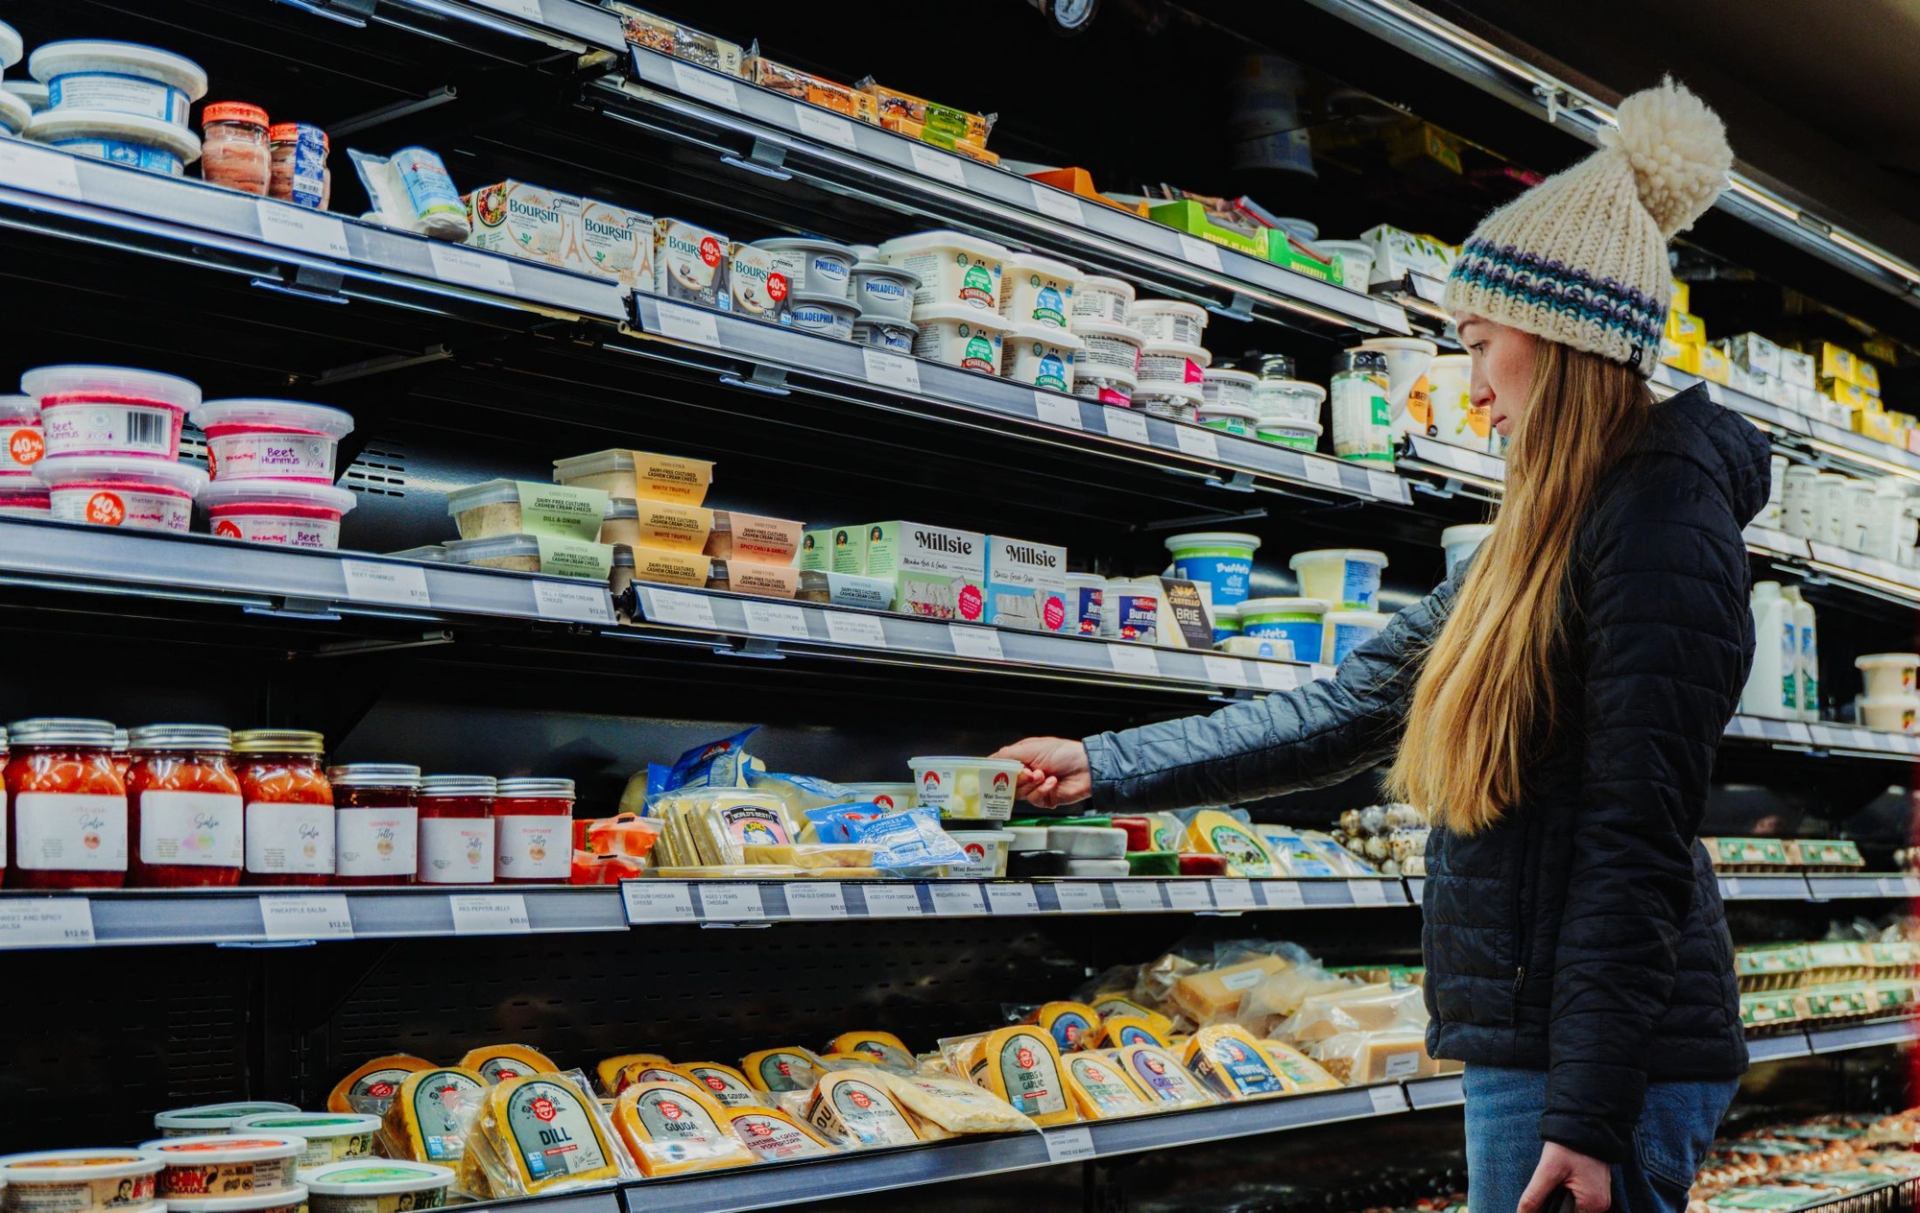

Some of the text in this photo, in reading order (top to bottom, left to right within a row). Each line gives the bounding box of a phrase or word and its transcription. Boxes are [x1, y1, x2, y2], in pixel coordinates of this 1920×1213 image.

[13, 438, 43, 452] 40%
[268, 447, 296, 457] Beet
[20, 453, 37, 461] OFF
[297, 532, 321, 543] Beet
[915, 531, 973, 555] Millsie
[1006, 545, 1057, 568] Millsie
[1176, 607, 1200, 622] BRIE
[194, 813, 220, 829] Salsa
[665, 1121, 698, 1131] GOUDA
[539, 1127, 573, 1146] DILL
